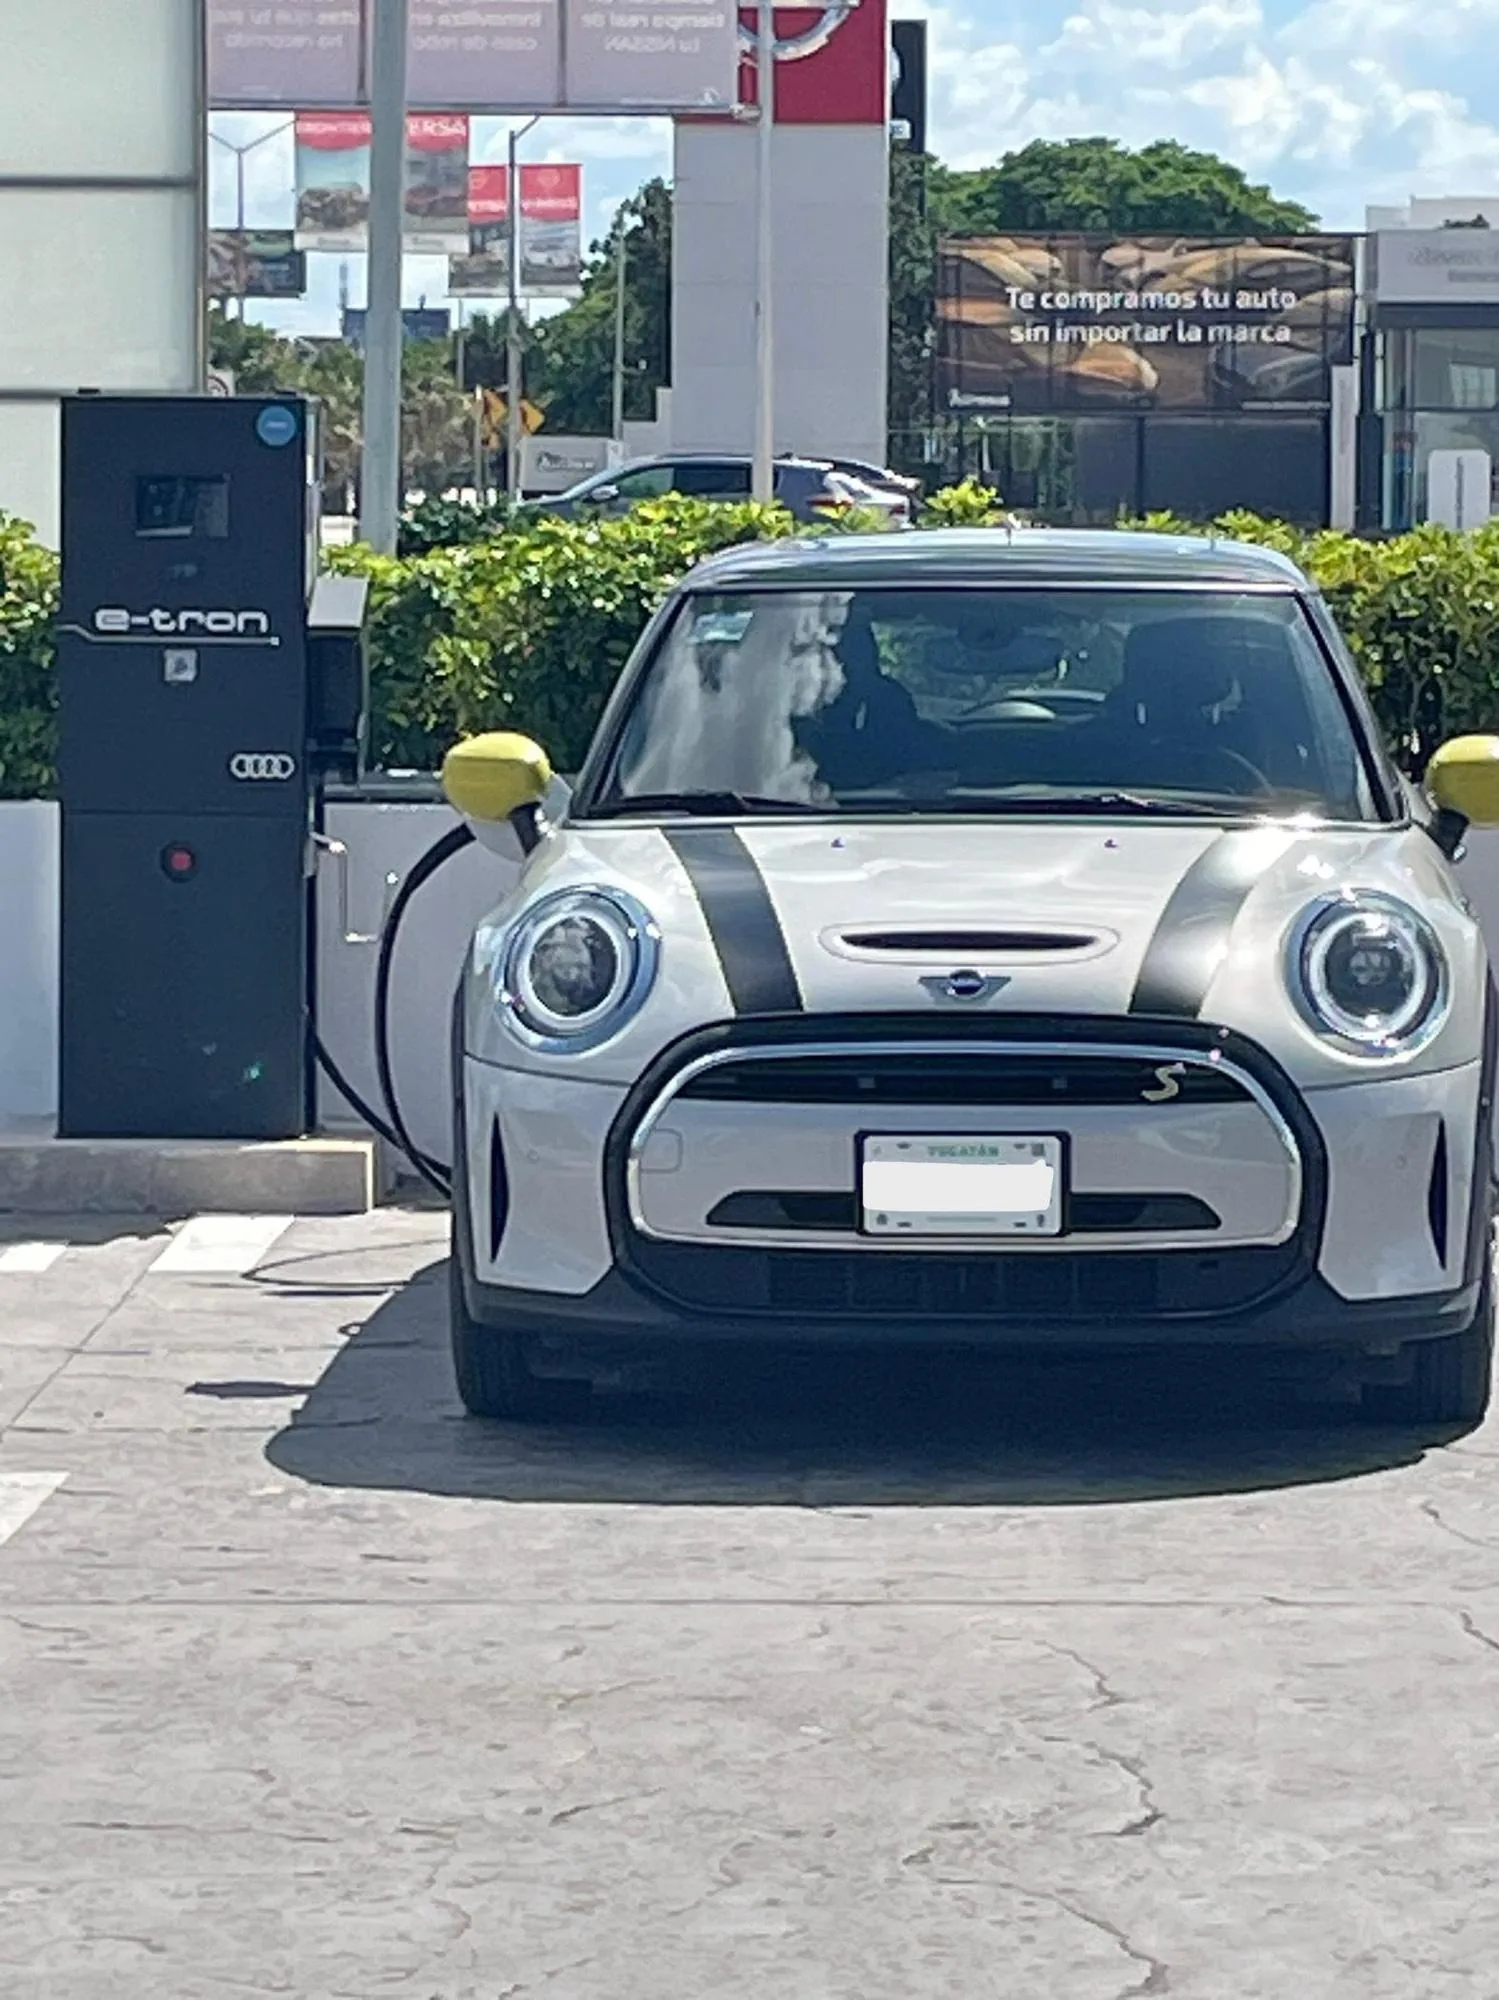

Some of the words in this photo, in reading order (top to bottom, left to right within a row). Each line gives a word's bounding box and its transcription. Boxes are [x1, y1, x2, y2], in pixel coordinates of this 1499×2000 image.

[405, 114, 467, 137] ERSA
[1005, 287, 1035, 309] Te
[1040, 289, 1197, 314] compramos
[1202, 289, 1230, 309] tu
[1235, 287, 1297, 309] auto
[1010, 319, 1050, 343] sin
[1056, 319, 1171, 345] importar
[1177, 318, 1201, 343] la
[1207, 324, 1292, 343] marca
[95, 608, 268, 633] e-tron
[1141, 1062, 1187, 1102] S
